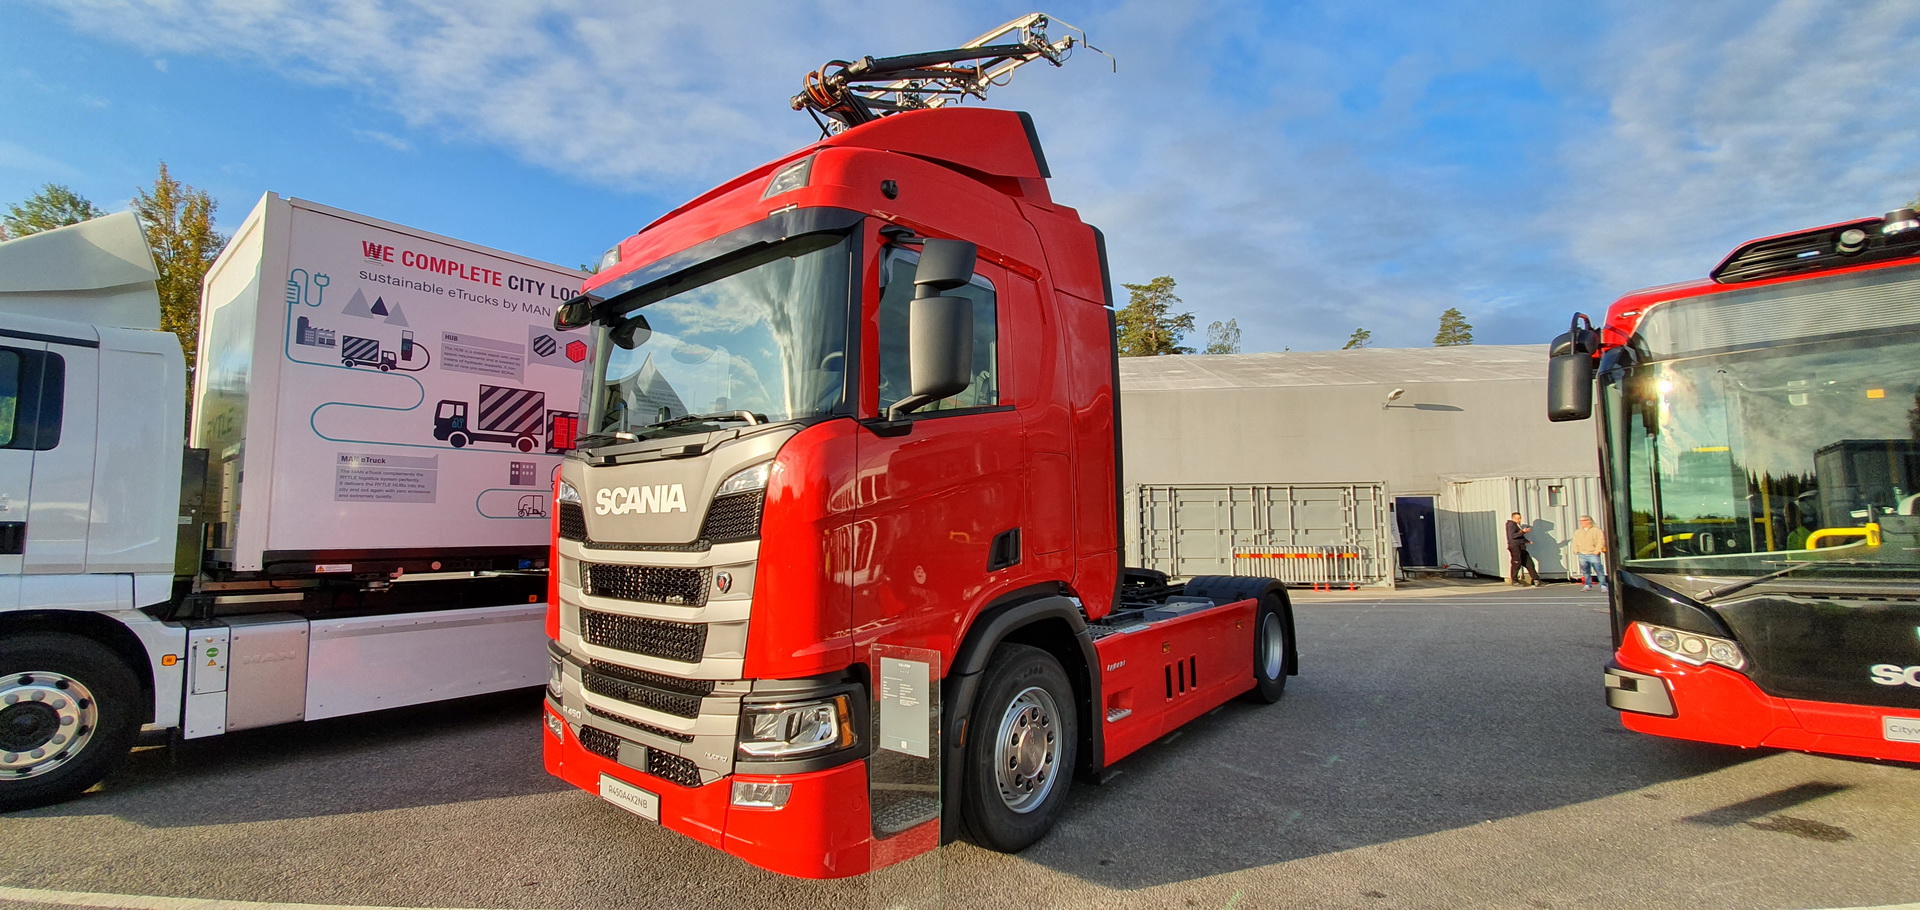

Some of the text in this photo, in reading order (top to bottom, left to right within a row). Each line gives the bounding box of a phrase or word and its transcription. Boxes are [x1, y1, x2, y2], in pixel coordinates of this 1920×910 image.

[362, 241, 395, 263] WE
[401, 250, 502, 287] COMPLETE
[508, 275, 546, 296] CITY
[359, 269, 551, 317] sustainable eTrucks by MAN
[595, 484, 687, 516] SCANIA
[563, 705, 582, 719] R 450
[608, 784, 648, 809] R450A4X2NB
